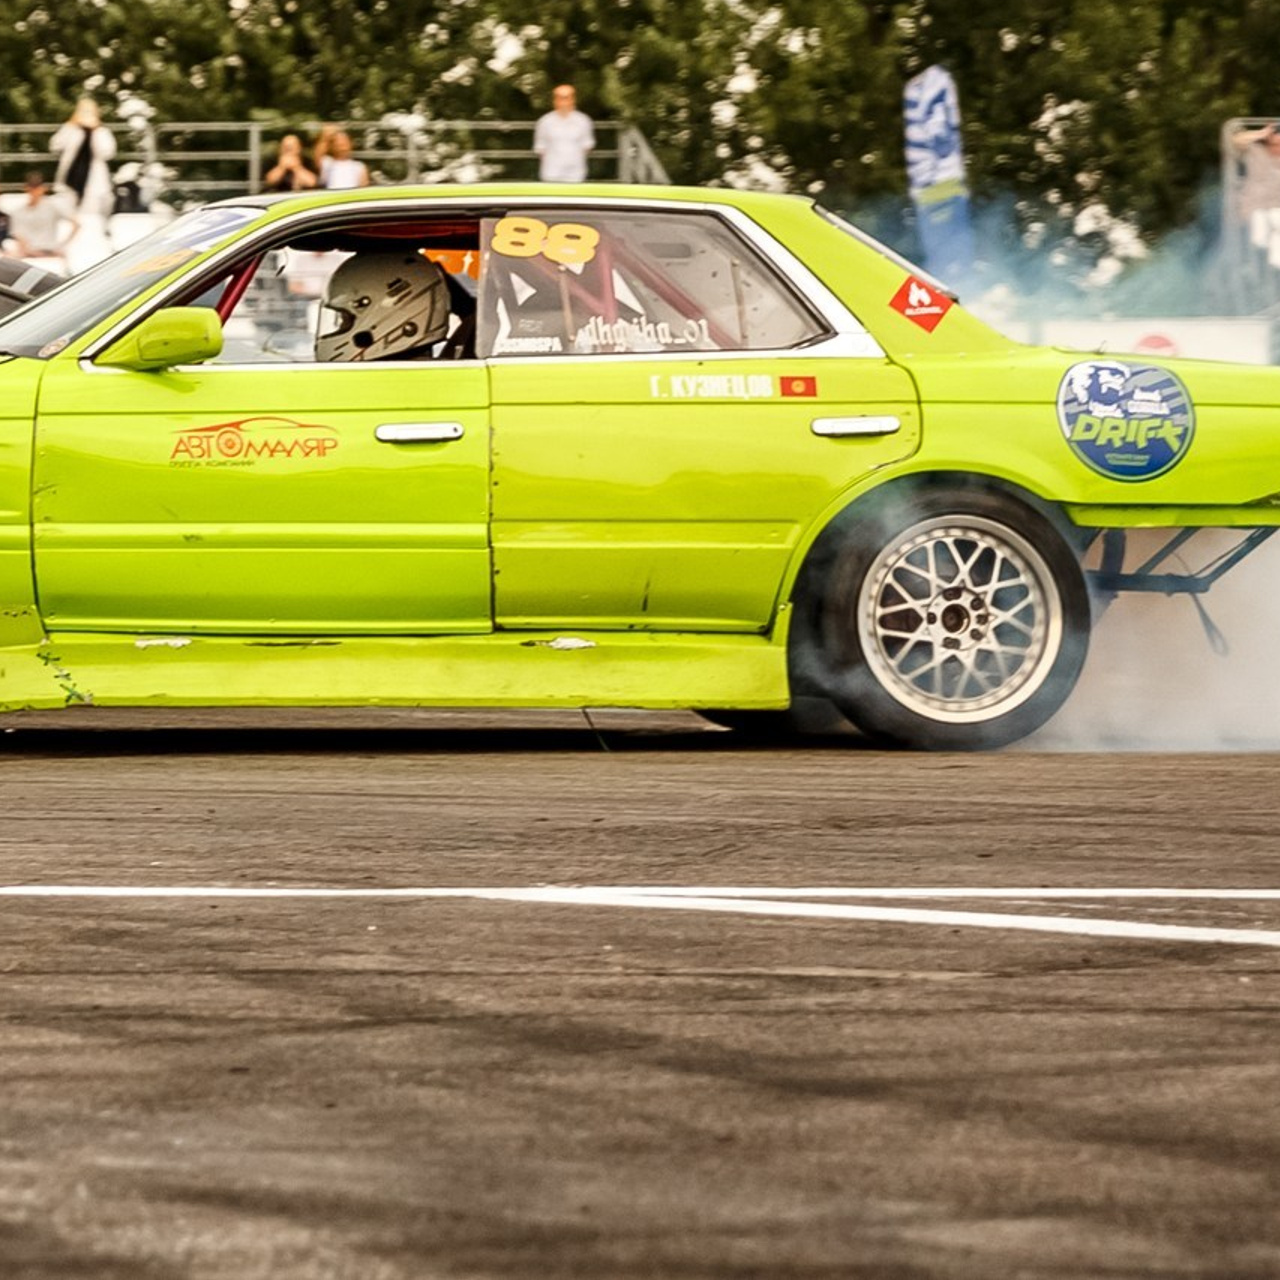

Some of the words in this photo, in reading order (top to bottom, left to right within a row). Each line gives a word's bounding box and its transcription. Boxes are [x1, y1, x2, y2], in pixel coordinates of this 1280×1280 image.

[491, 216, 600, 264] 88
[170, 429, 338, 459] АВТОМАЛЯР
[1070, 413, 1185, 452] DRIFT
